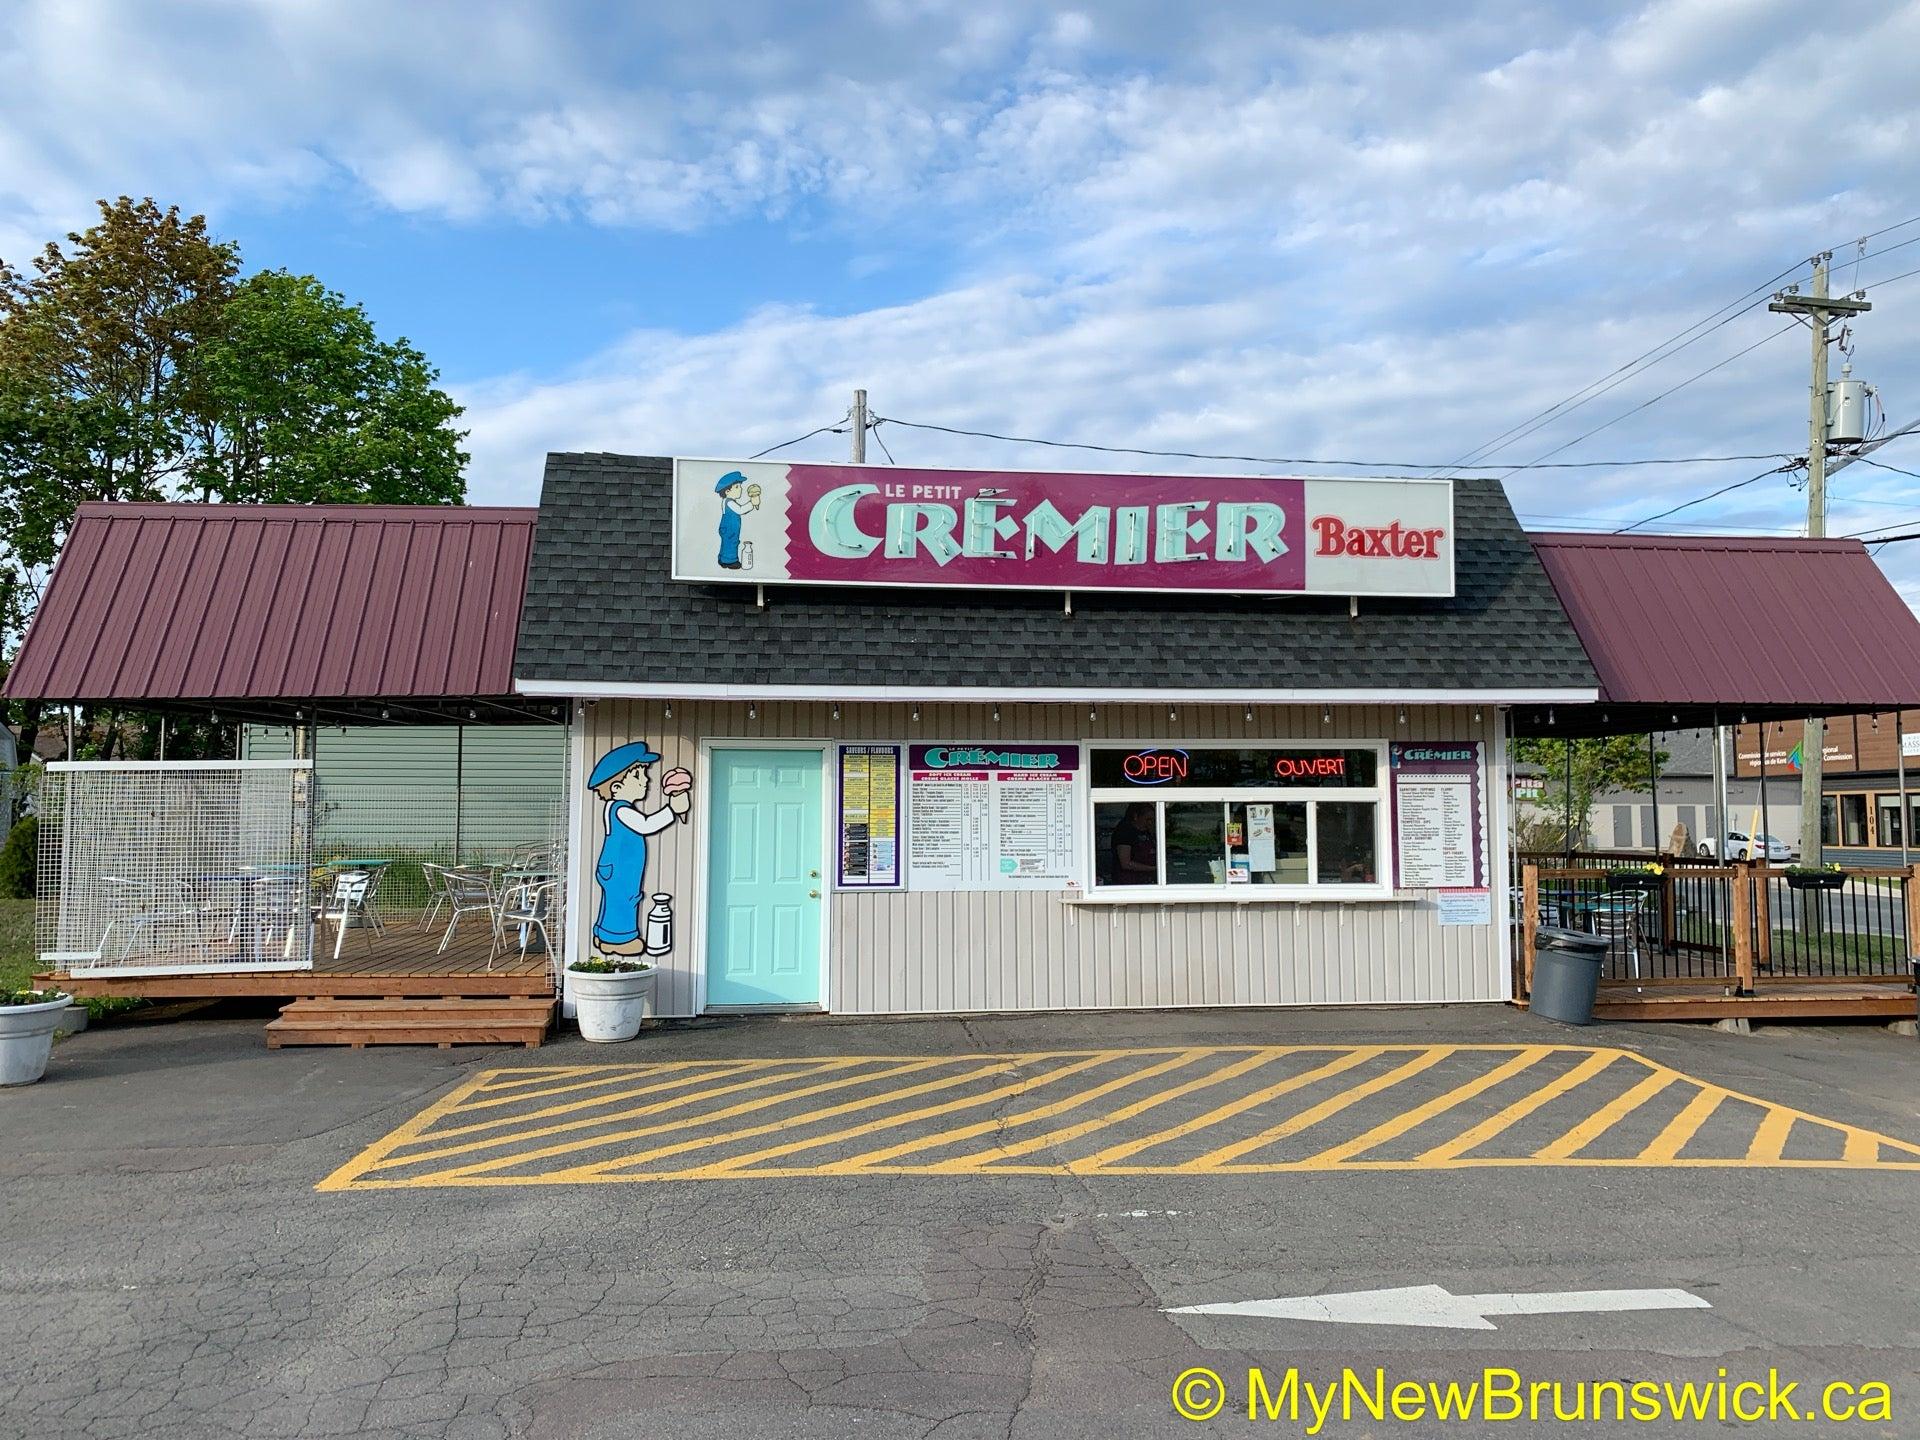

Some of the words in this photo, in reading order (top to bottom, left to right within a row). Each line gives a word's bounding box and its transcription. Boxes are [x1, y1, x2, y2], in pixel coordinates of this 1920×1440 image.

[885, 483, 906, 498] LE
[912, 484, 962, 500] PETIT
[808, 483, 1290, 568] CRÉMIER
[1311, 513, 1445, 561] Baxter
[1123, 755, 1188, 777] OPEN
[1276, 758, 1345, 776] OUVERT
